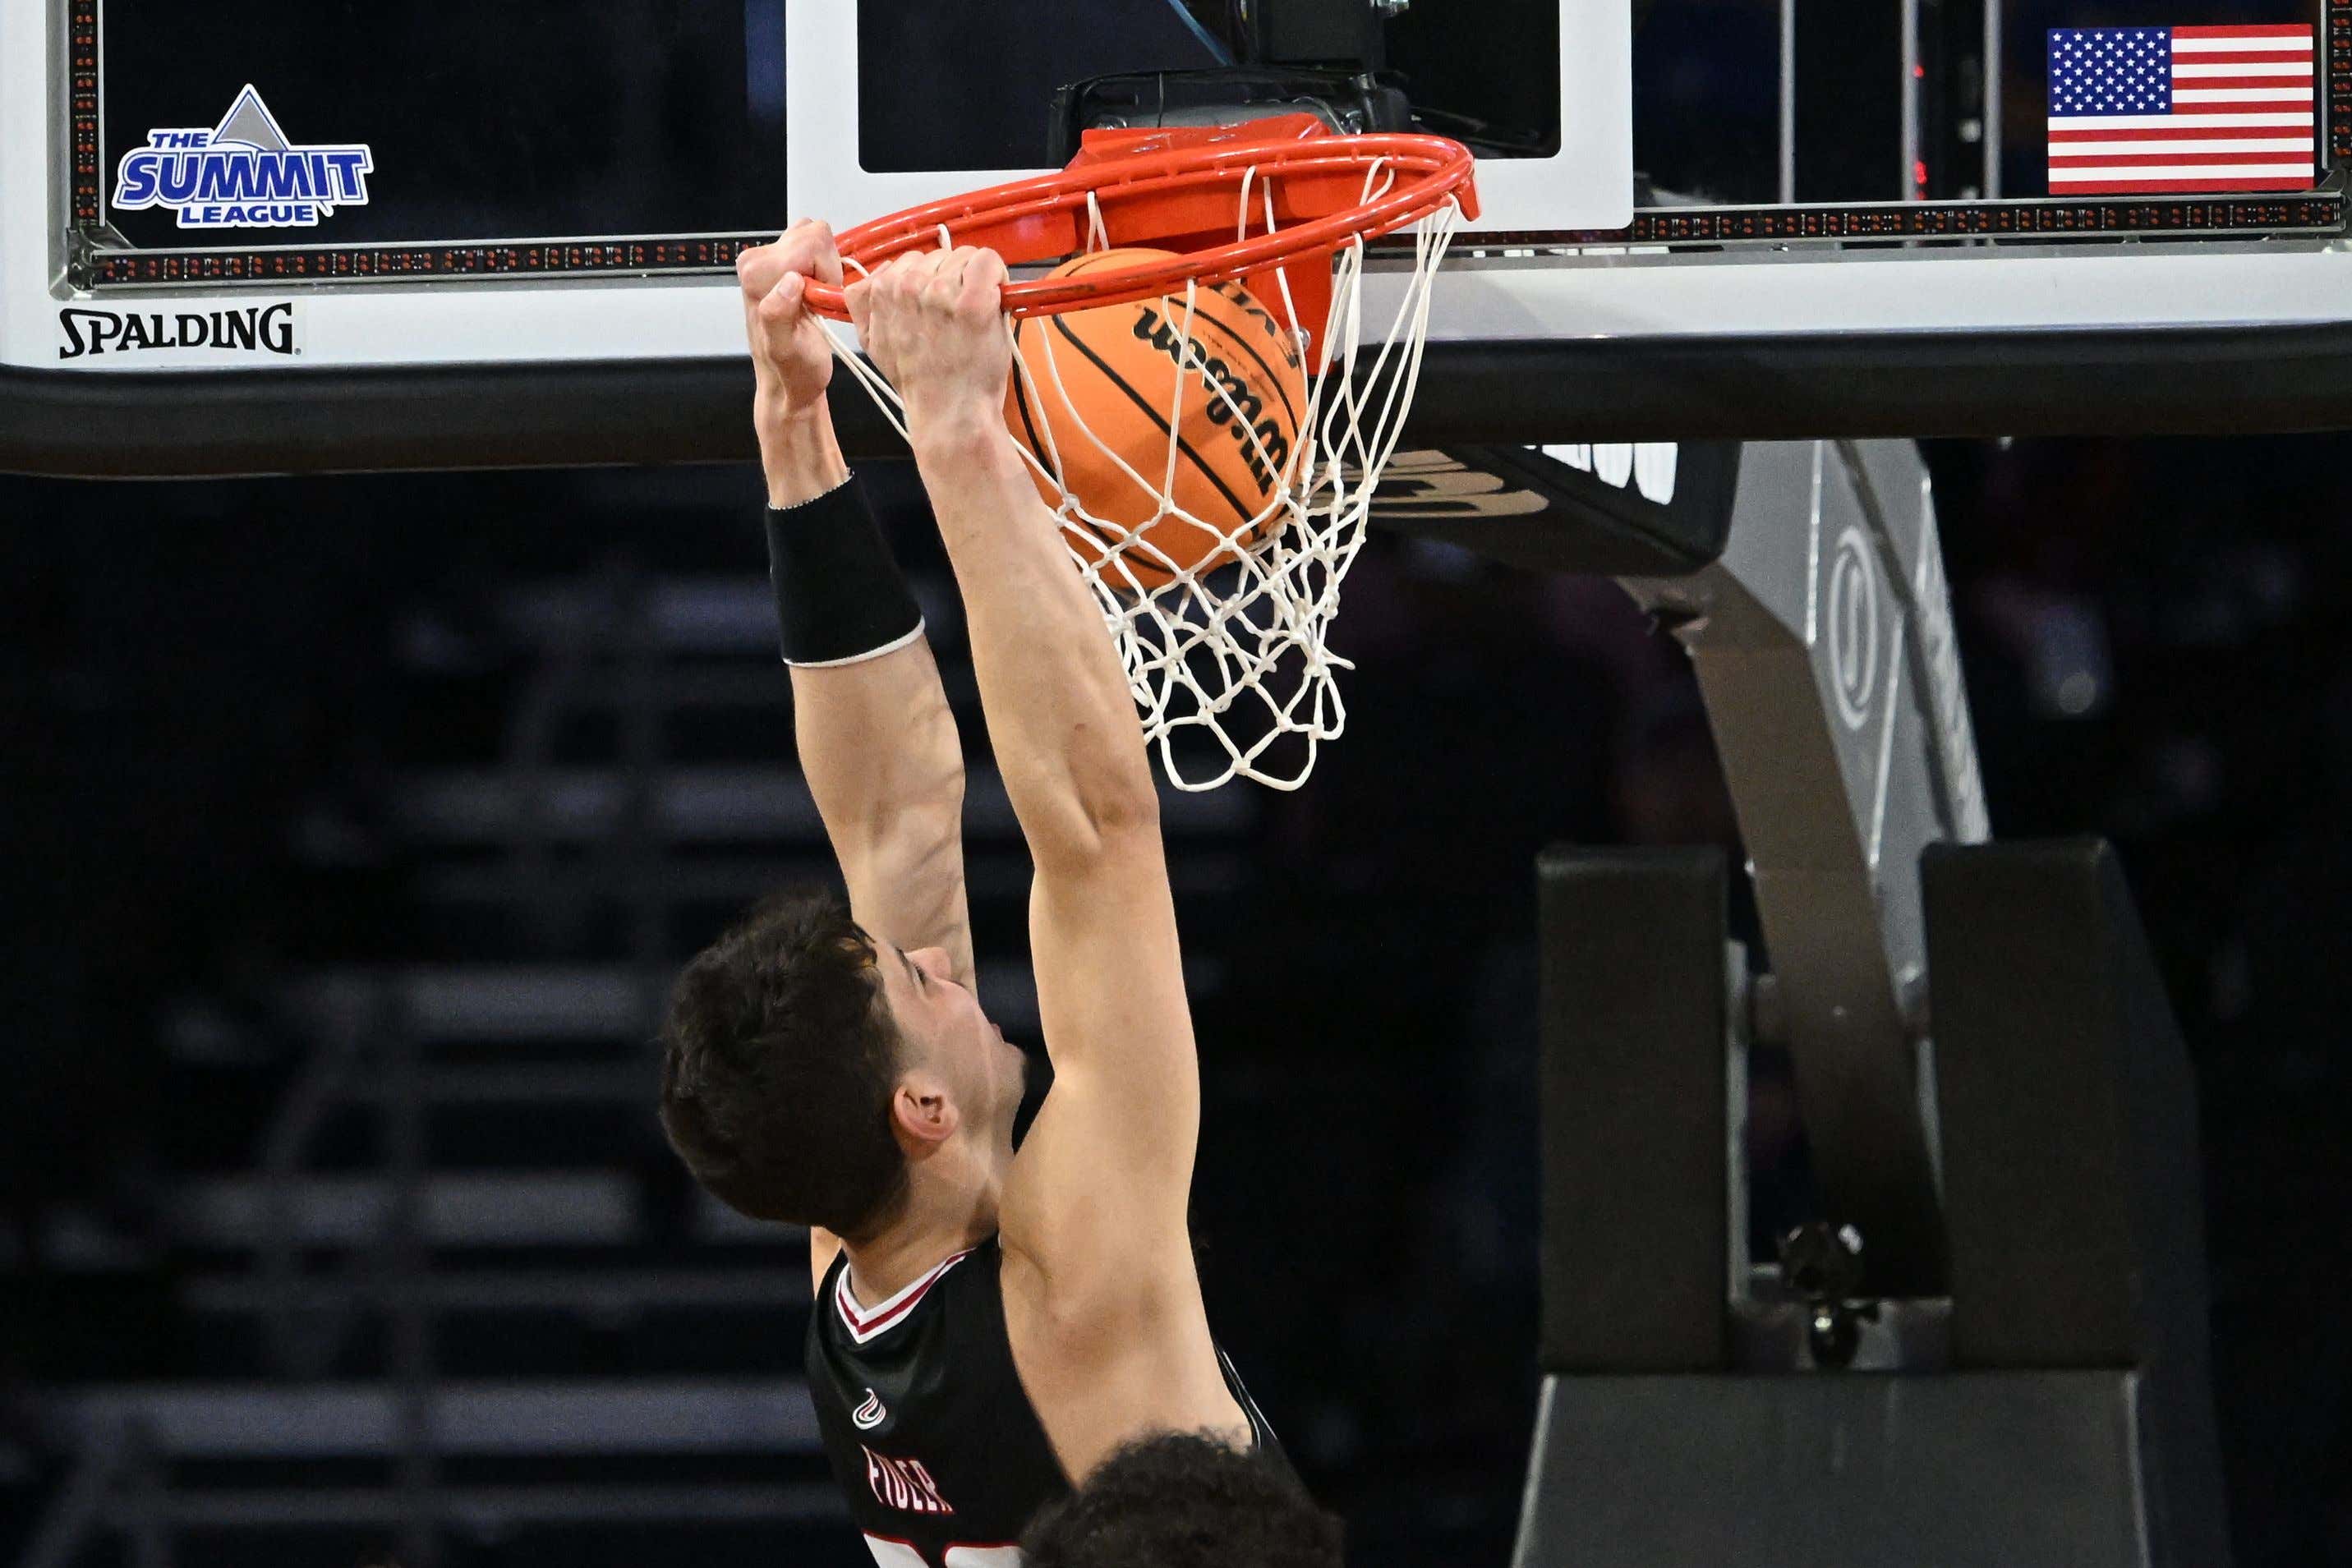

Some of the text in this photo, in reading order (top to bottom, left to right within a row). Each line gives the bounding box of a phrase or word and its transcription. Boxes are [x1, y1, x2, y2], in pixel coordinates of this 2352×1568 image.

[152, 132, 209, 149] THE
[118, 151, 370, 205] SUMMIT
[180, 206, 314, 224] LEAGUE
[59, 302, 292, 360] SPALDING
[1132, 306, 1290, 497] Wilson
